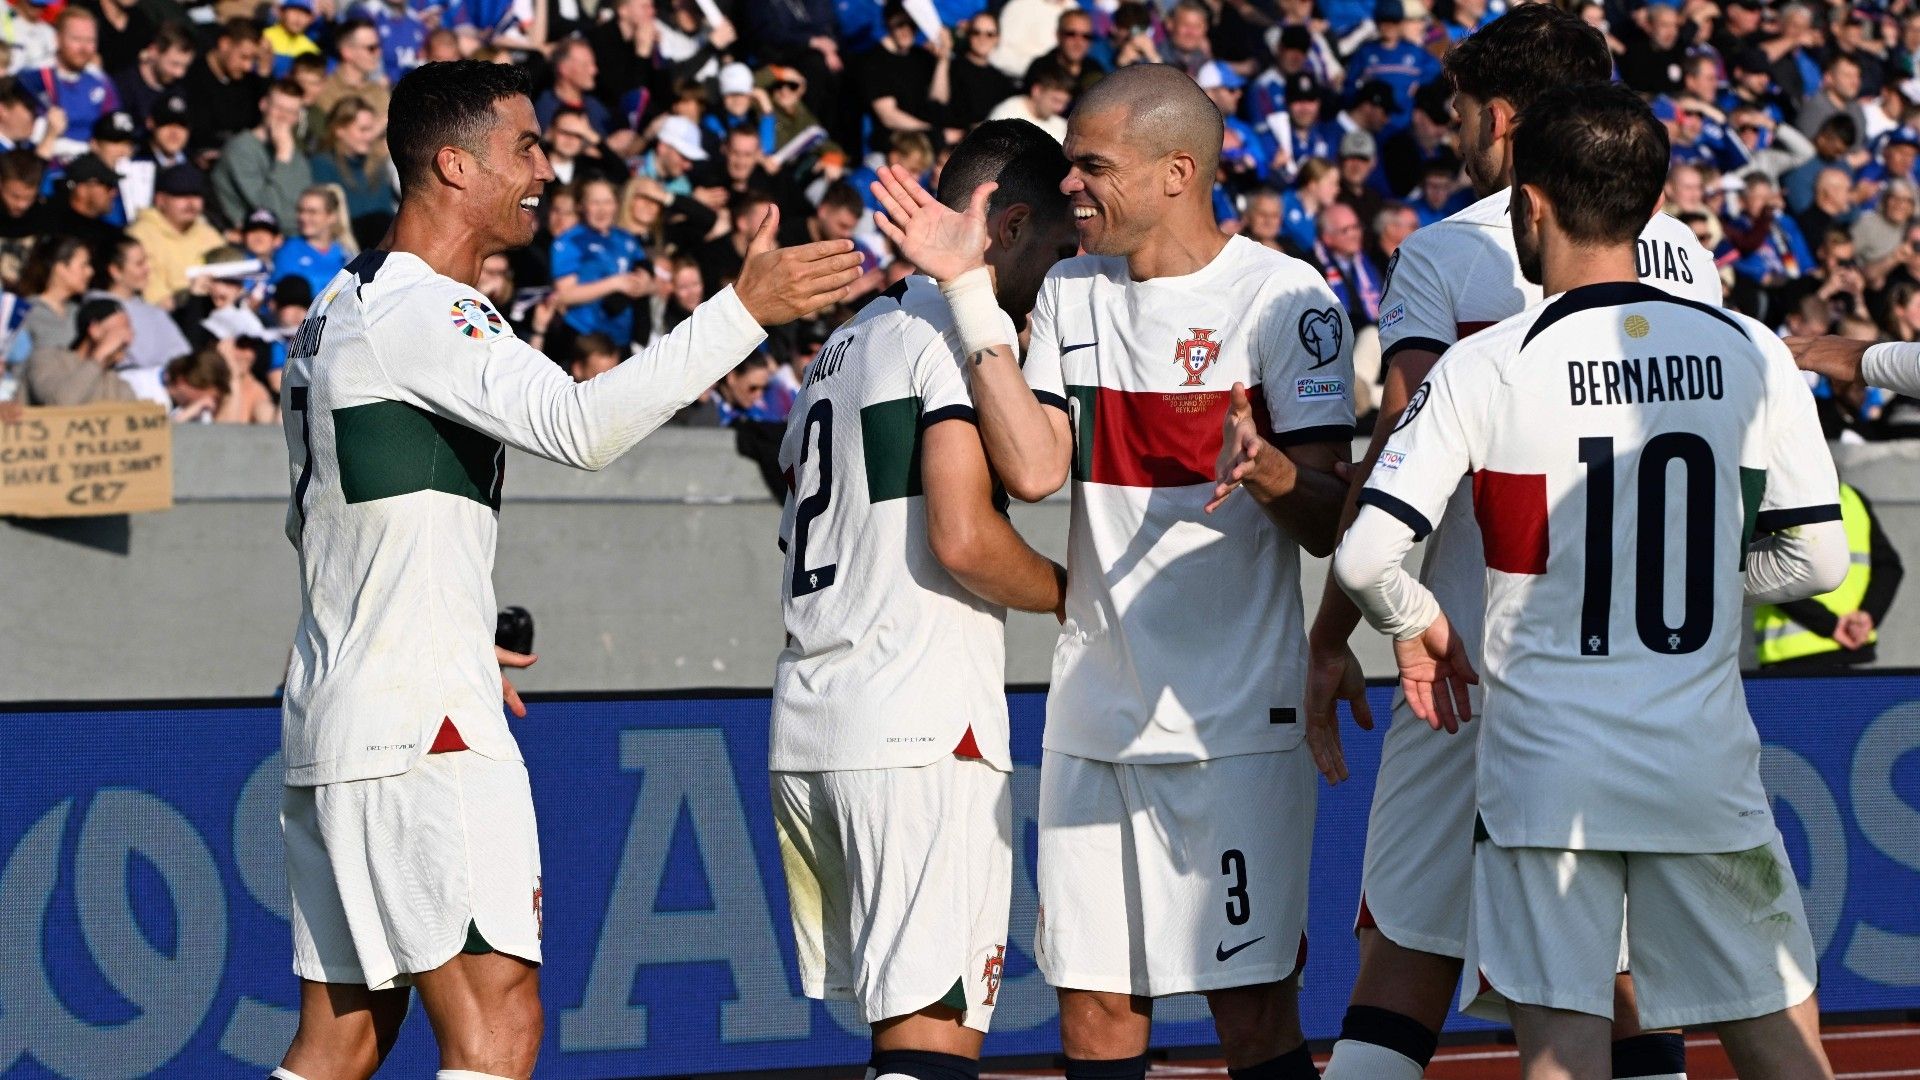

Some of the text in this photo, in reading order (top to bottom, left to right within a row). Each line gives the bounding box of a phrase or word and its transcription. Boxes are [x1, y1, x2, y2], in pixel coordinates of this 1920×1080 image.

[1637, 239, 1693, 284] DIAS
[805, 335, 855, 390] ALOT
[1568, 355, 1723, 406] BERNARDO
[0, 446, 47, 463] CAN
[75, 439, 141, 454] PLEASE
[67, 418, 110, 437] MY
[3, 463, 60, 485] HAVE
[66, 481, 126, 505] CR7
[792, 398, 837, 598] 2
[1579, 432, 1716, 656] 10
[1221, 849, 1250, 926] 3
